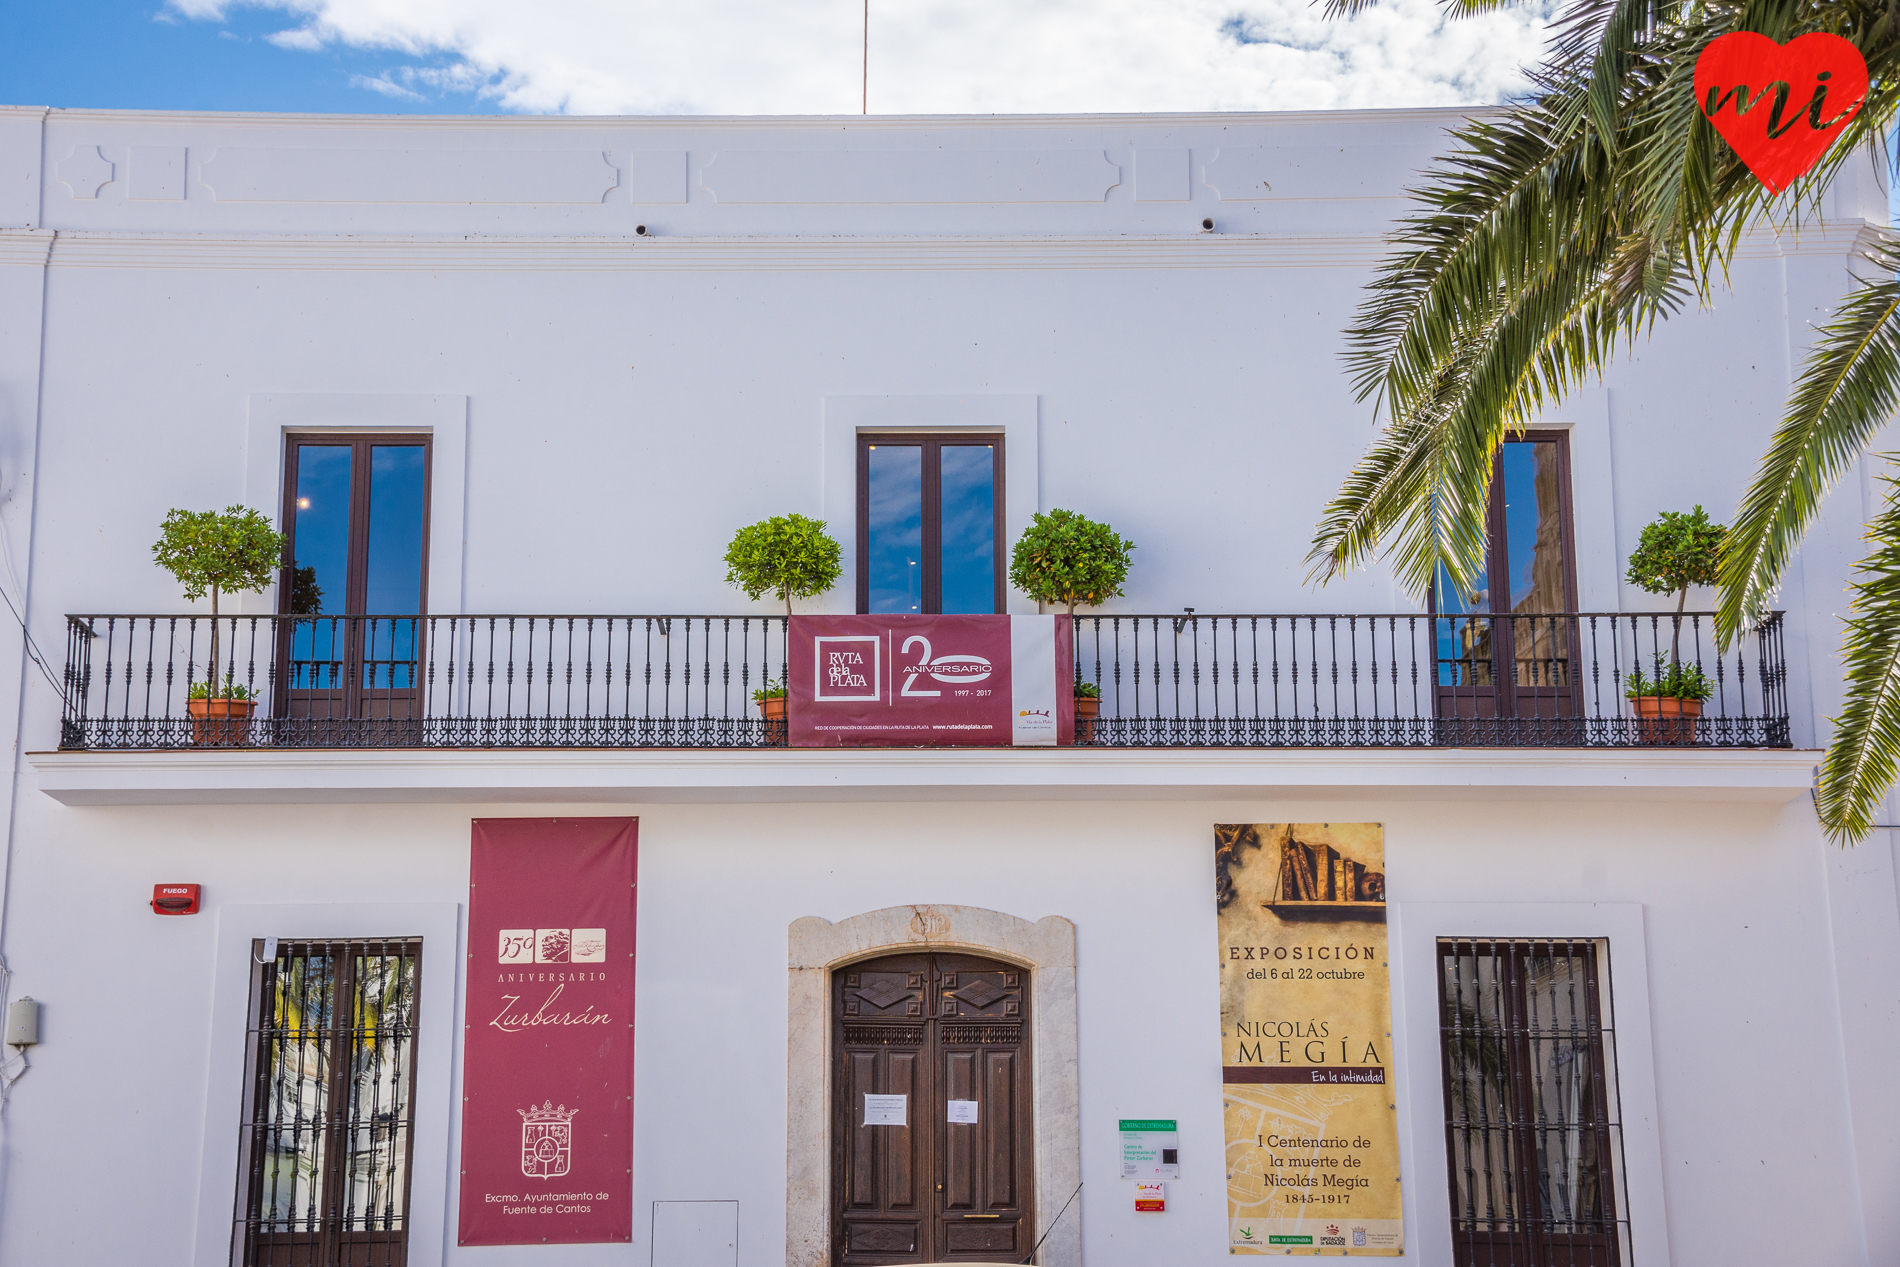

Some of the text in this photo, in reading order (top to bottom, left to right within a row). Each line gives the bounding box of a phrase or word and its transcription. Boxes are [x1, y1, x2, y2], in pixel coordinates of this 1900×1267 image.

[903, 665, 993, 673] ANIVERSARIO
[829, 674, 868, 687] PLATA
[917, 916, 946, 933] 1912
[1229, 943, 1375, 960] EXPOSICIÓN
[498, 972, 606, 983] ANIVERSARIO
[1246, 968, 1365, 979] del 6 al 22 octubre
[489, 983, 612, 1033] Zurbarán
[1236, 1018, 1329, 1038] NICOLÁS
[1238, 1035, 1382, 1063] MEGÍA
[1311, 1069, 1385, 1084] En la intimidad
[1258, 1134, 1371, 1148] I Centenario de
[1269, 1154, 1361, 1167] la muerte de
[1264, 1173, 1369, 1190] Nicolás Megía
[485, 1191, 609, 1203] Excmo. Ayuntamiento de
[1285, 1194, 1350, 1204] 1845-1917
[503, 1203, 591, 1214] Fuente de Cantos
